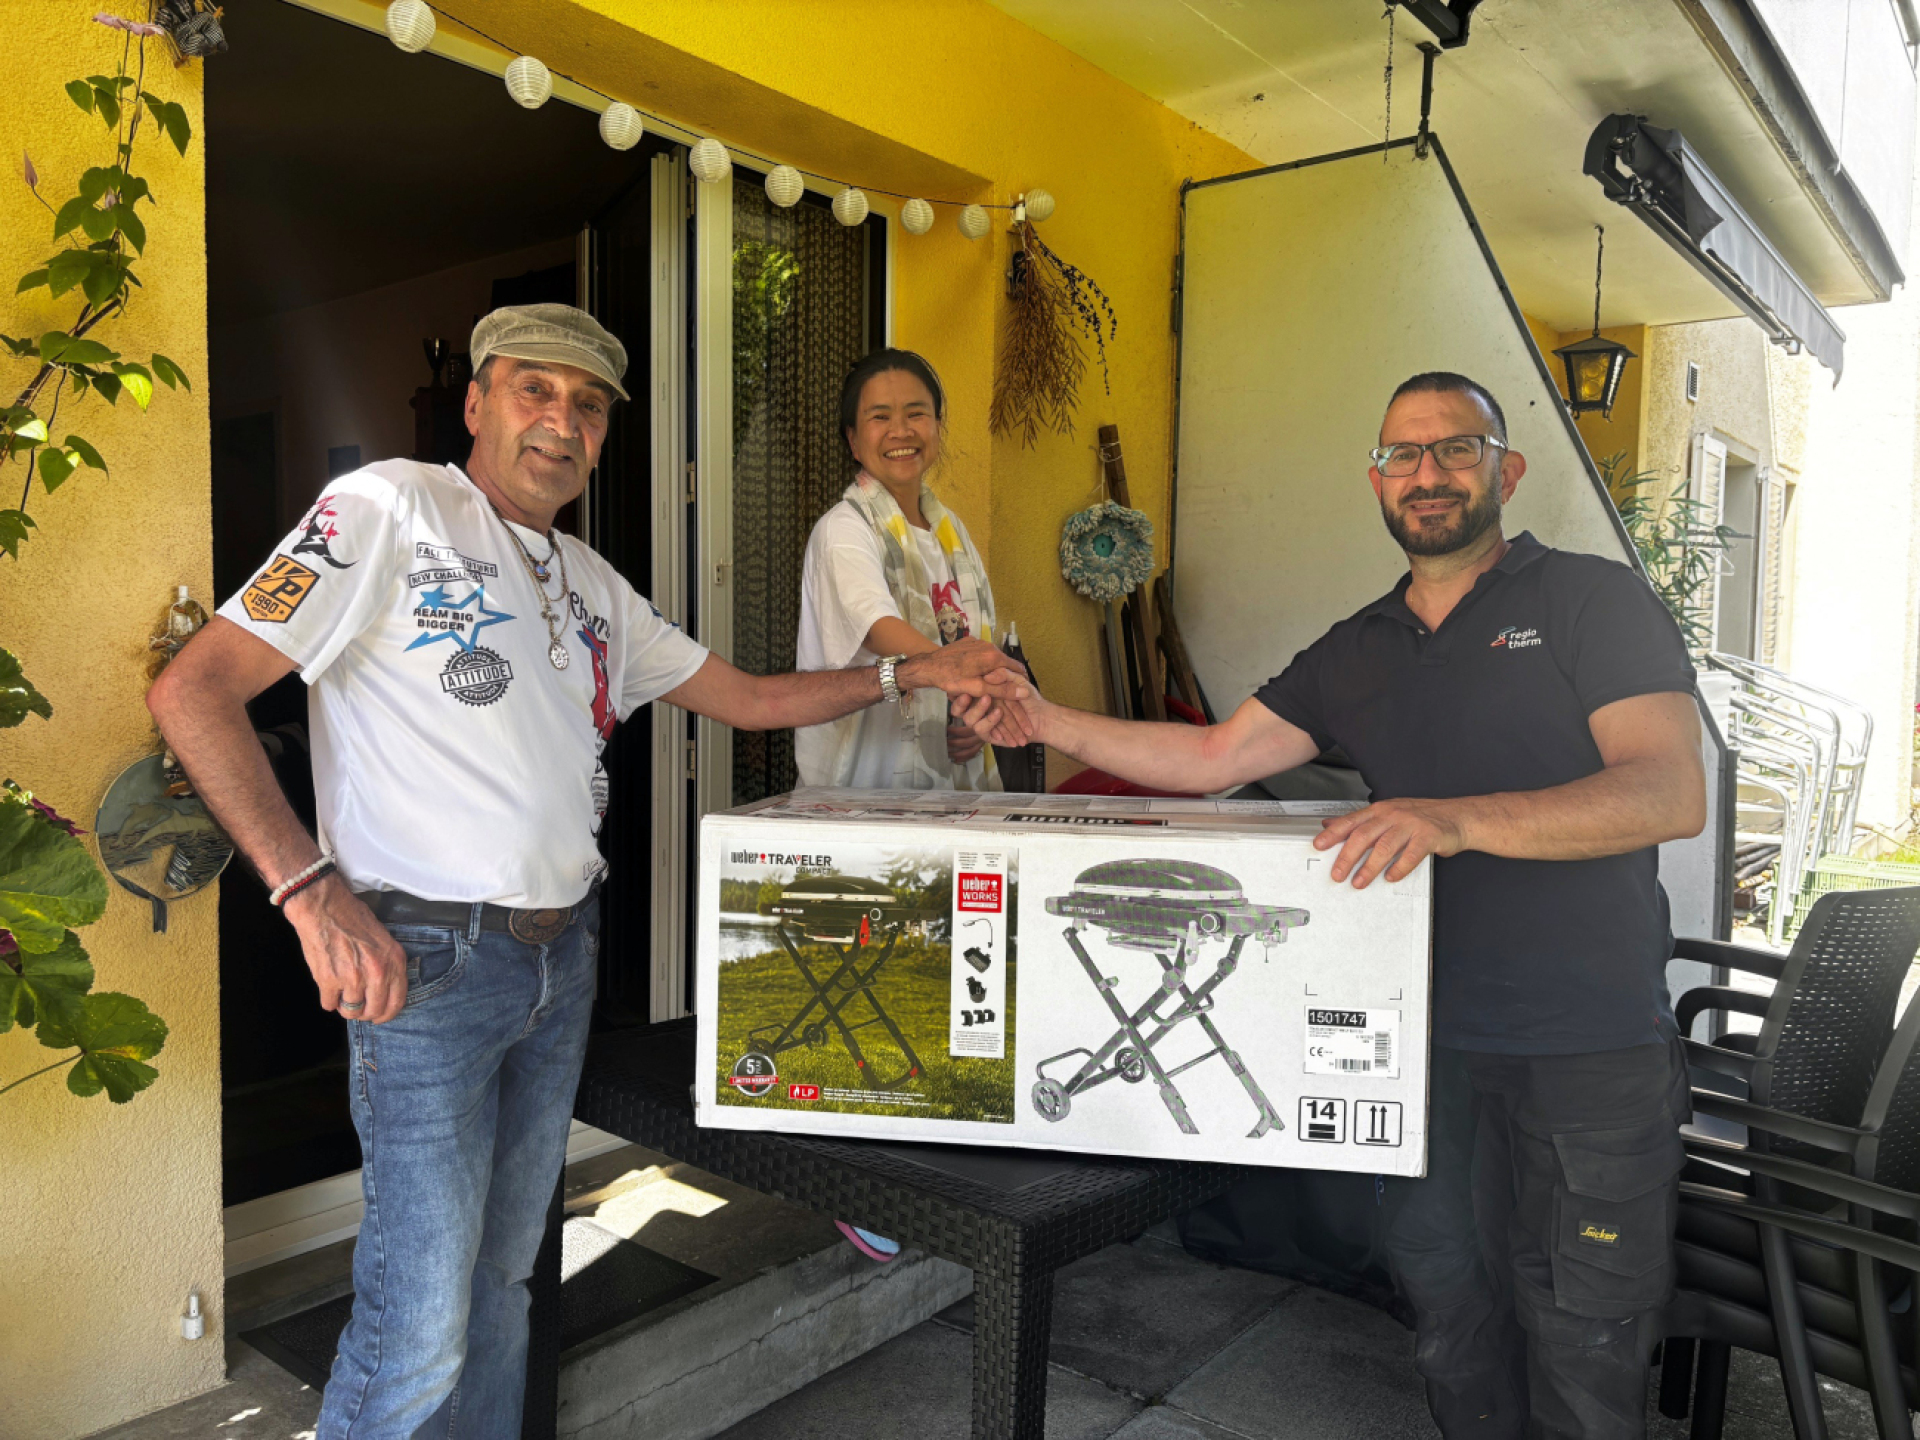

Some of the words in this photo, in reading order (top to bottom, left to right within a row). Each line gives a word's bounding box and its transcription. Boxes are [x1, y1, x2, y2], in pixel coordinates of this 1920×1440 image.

[411, 572, 431, 584] NEW
[250, 593, 280, 614] 1990
[452, 611, 473, 622] BIG
[418, 618, 465, 631] BIGGER
[1510, 628, 1537, 641] regio
[1508, 637, 1541, 649] therm
[447, 663, 508, 688] ATTITUDE
[730, 849, 759, 865] weber
[767, 853, 832, 867] TRAVELER
[795, 866, 832, 875] COMPACT
[962, 876, 990, 892] weber
[962, 891, 998, 902] WORKS
[1309, 1011, 1366, 1026] 1501747
[746, 1058, 756, 1075] 5
[801, 1088, 815, 1097] LP
[1306, 1099, 1338, 1121] 14
